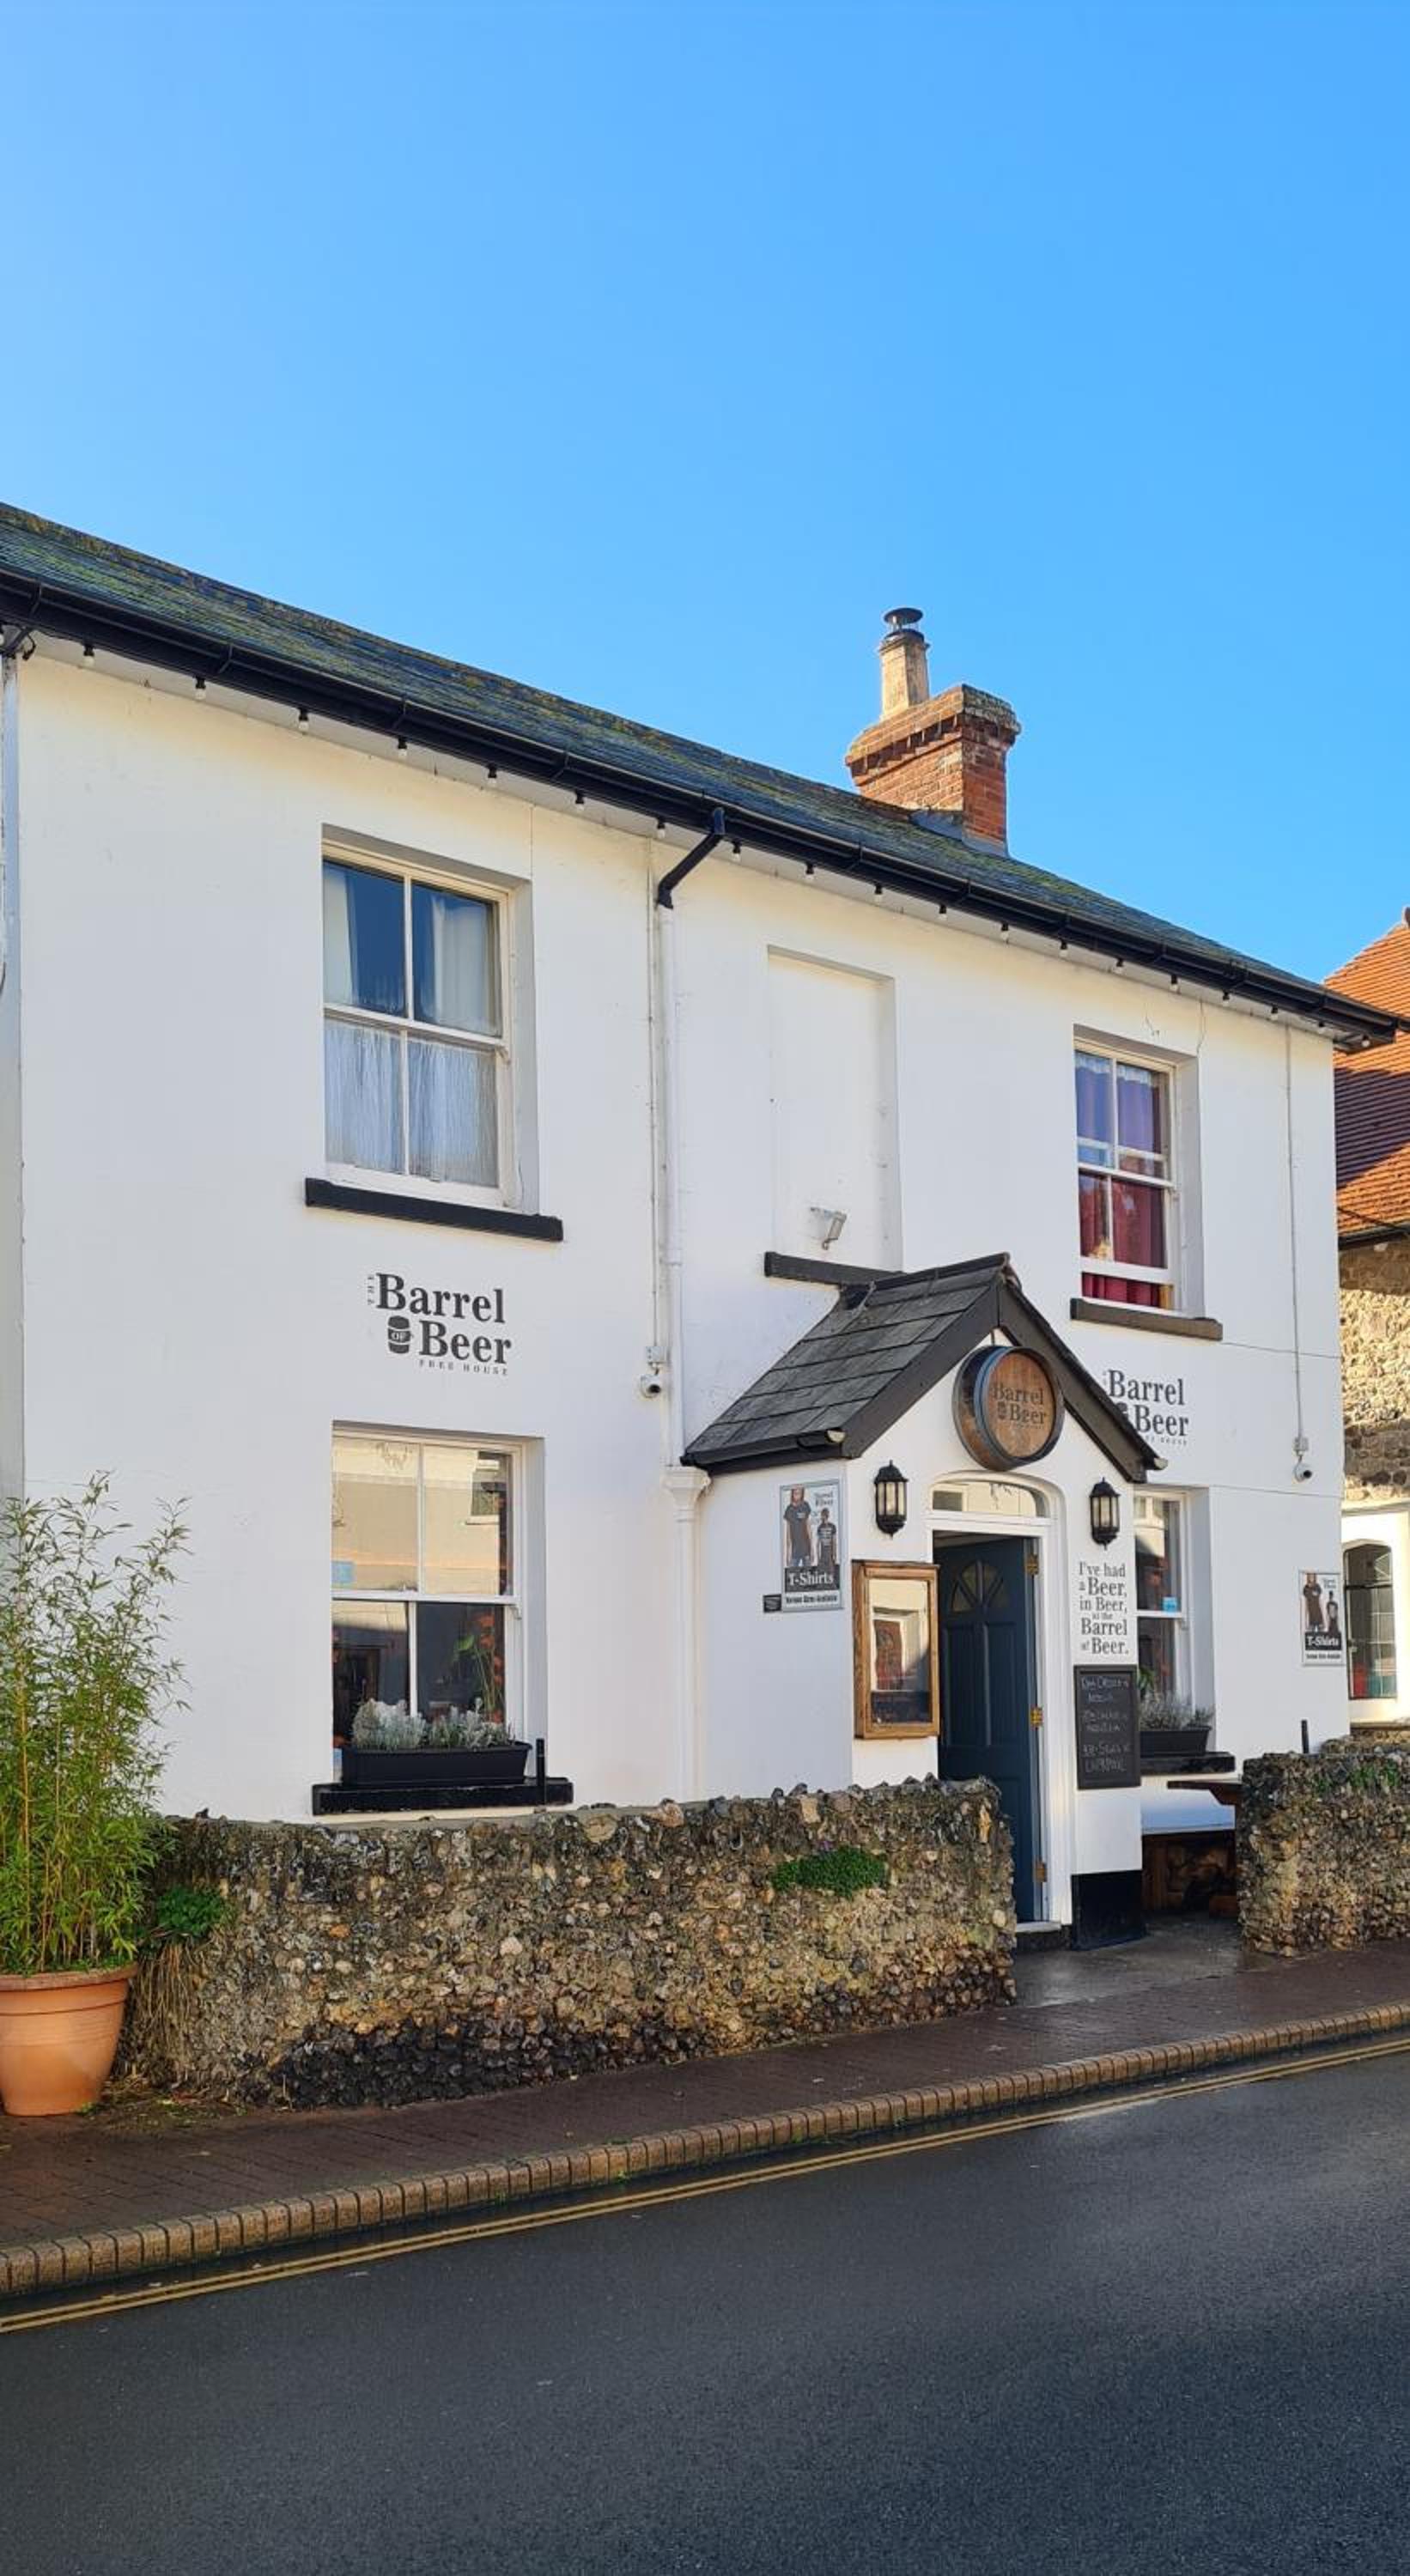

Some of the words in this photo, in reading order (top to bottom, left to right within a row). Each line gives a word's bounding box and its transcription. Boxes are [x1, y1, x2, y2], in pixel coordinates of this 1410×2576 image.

[375, 1272, 505, 1323] Barrel
[418, 1320, 512, 1364] Beer
[993, 1382, 1044, 1406] Barrel
[1108, 1369, 1185, 1406] Barrel
[1010, 1402, 1046, 1425] Beer
[1133, 1404, 1189, 1437] Beer
[788, 1571, 835, 1586] T-Shirts
[1079, 1561, 1100, 1577] I've
[1103, 1562, 1126, 1577] had
[1087, 1577, 1127, 1597] Beer,
[1079, 1595, 1091, 1611] in
[1096, 1596, 1127, 1614] Beer,
[1081, 1617, 1127, 1636] Barrel
[1091, 1637, 1129, 1655] Beer.
